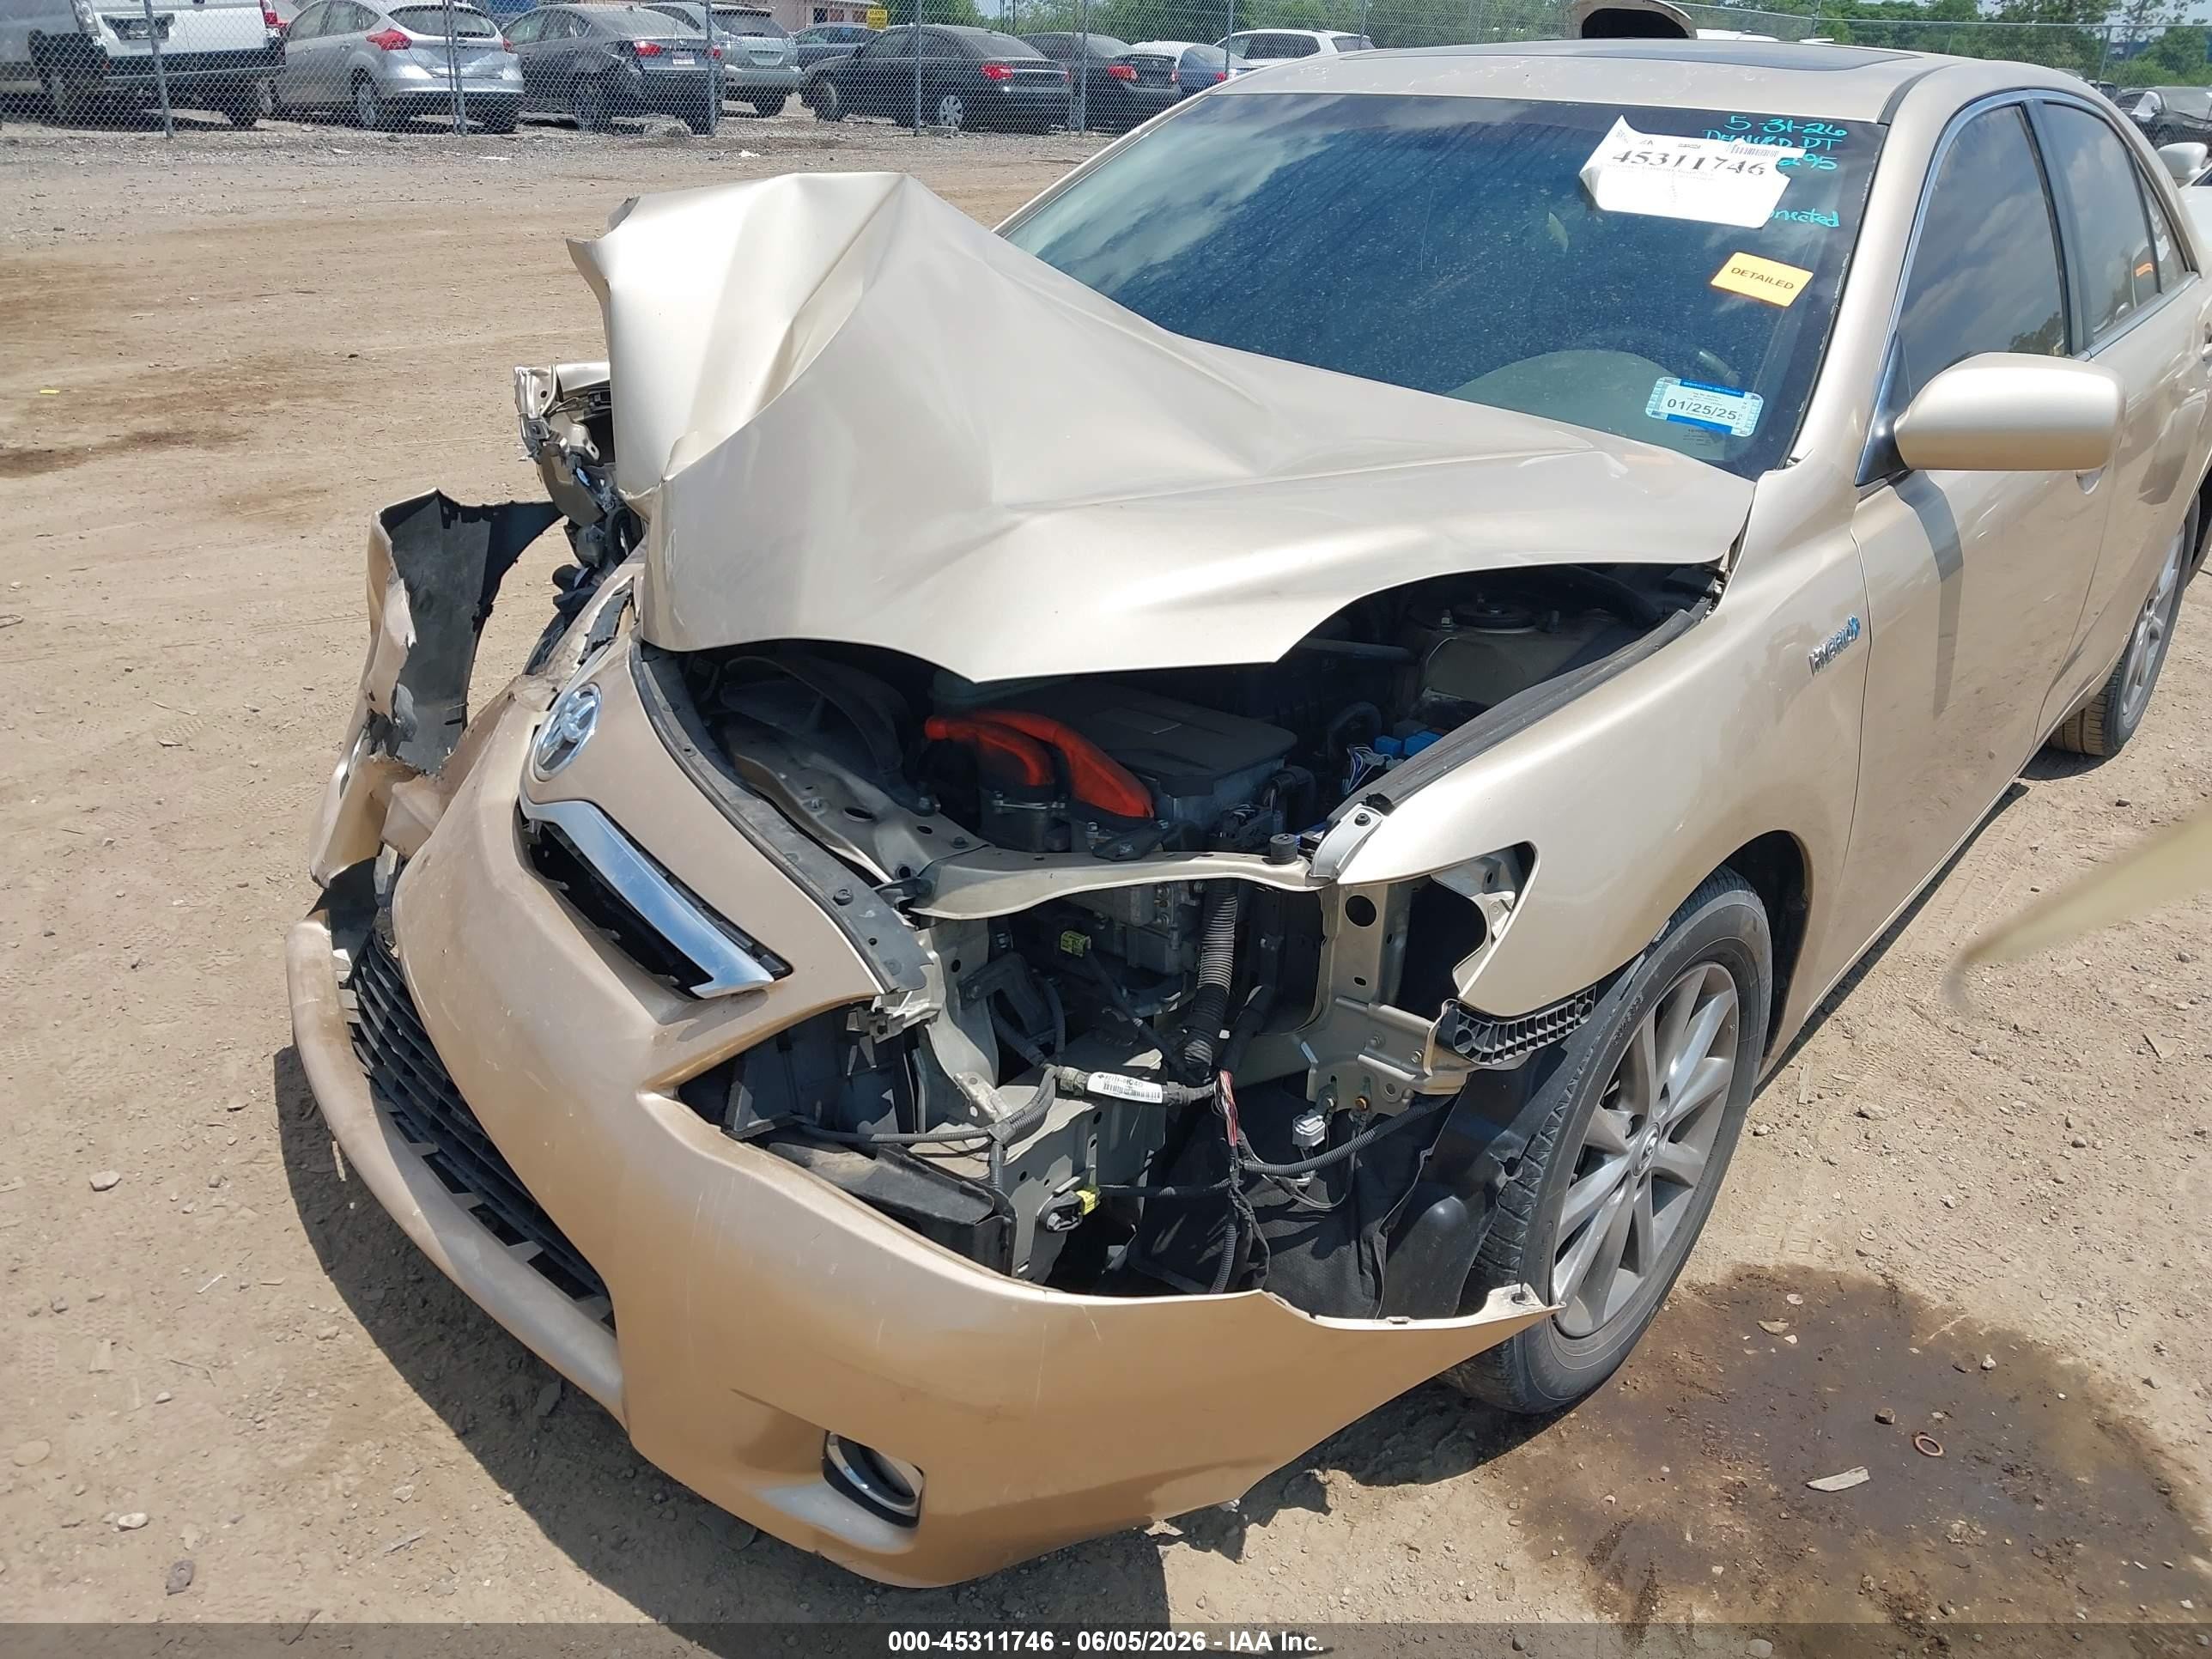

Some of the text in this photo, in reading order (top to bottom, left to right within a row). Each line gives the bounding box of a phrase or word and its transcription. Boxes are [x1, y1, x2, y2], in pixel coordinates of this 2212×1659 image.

[1612, 149, 1766, 176] 45311746
[1730, 267, 1795, 290] DETAILED
[1667, 398, 1738, 421] 01/25/25
